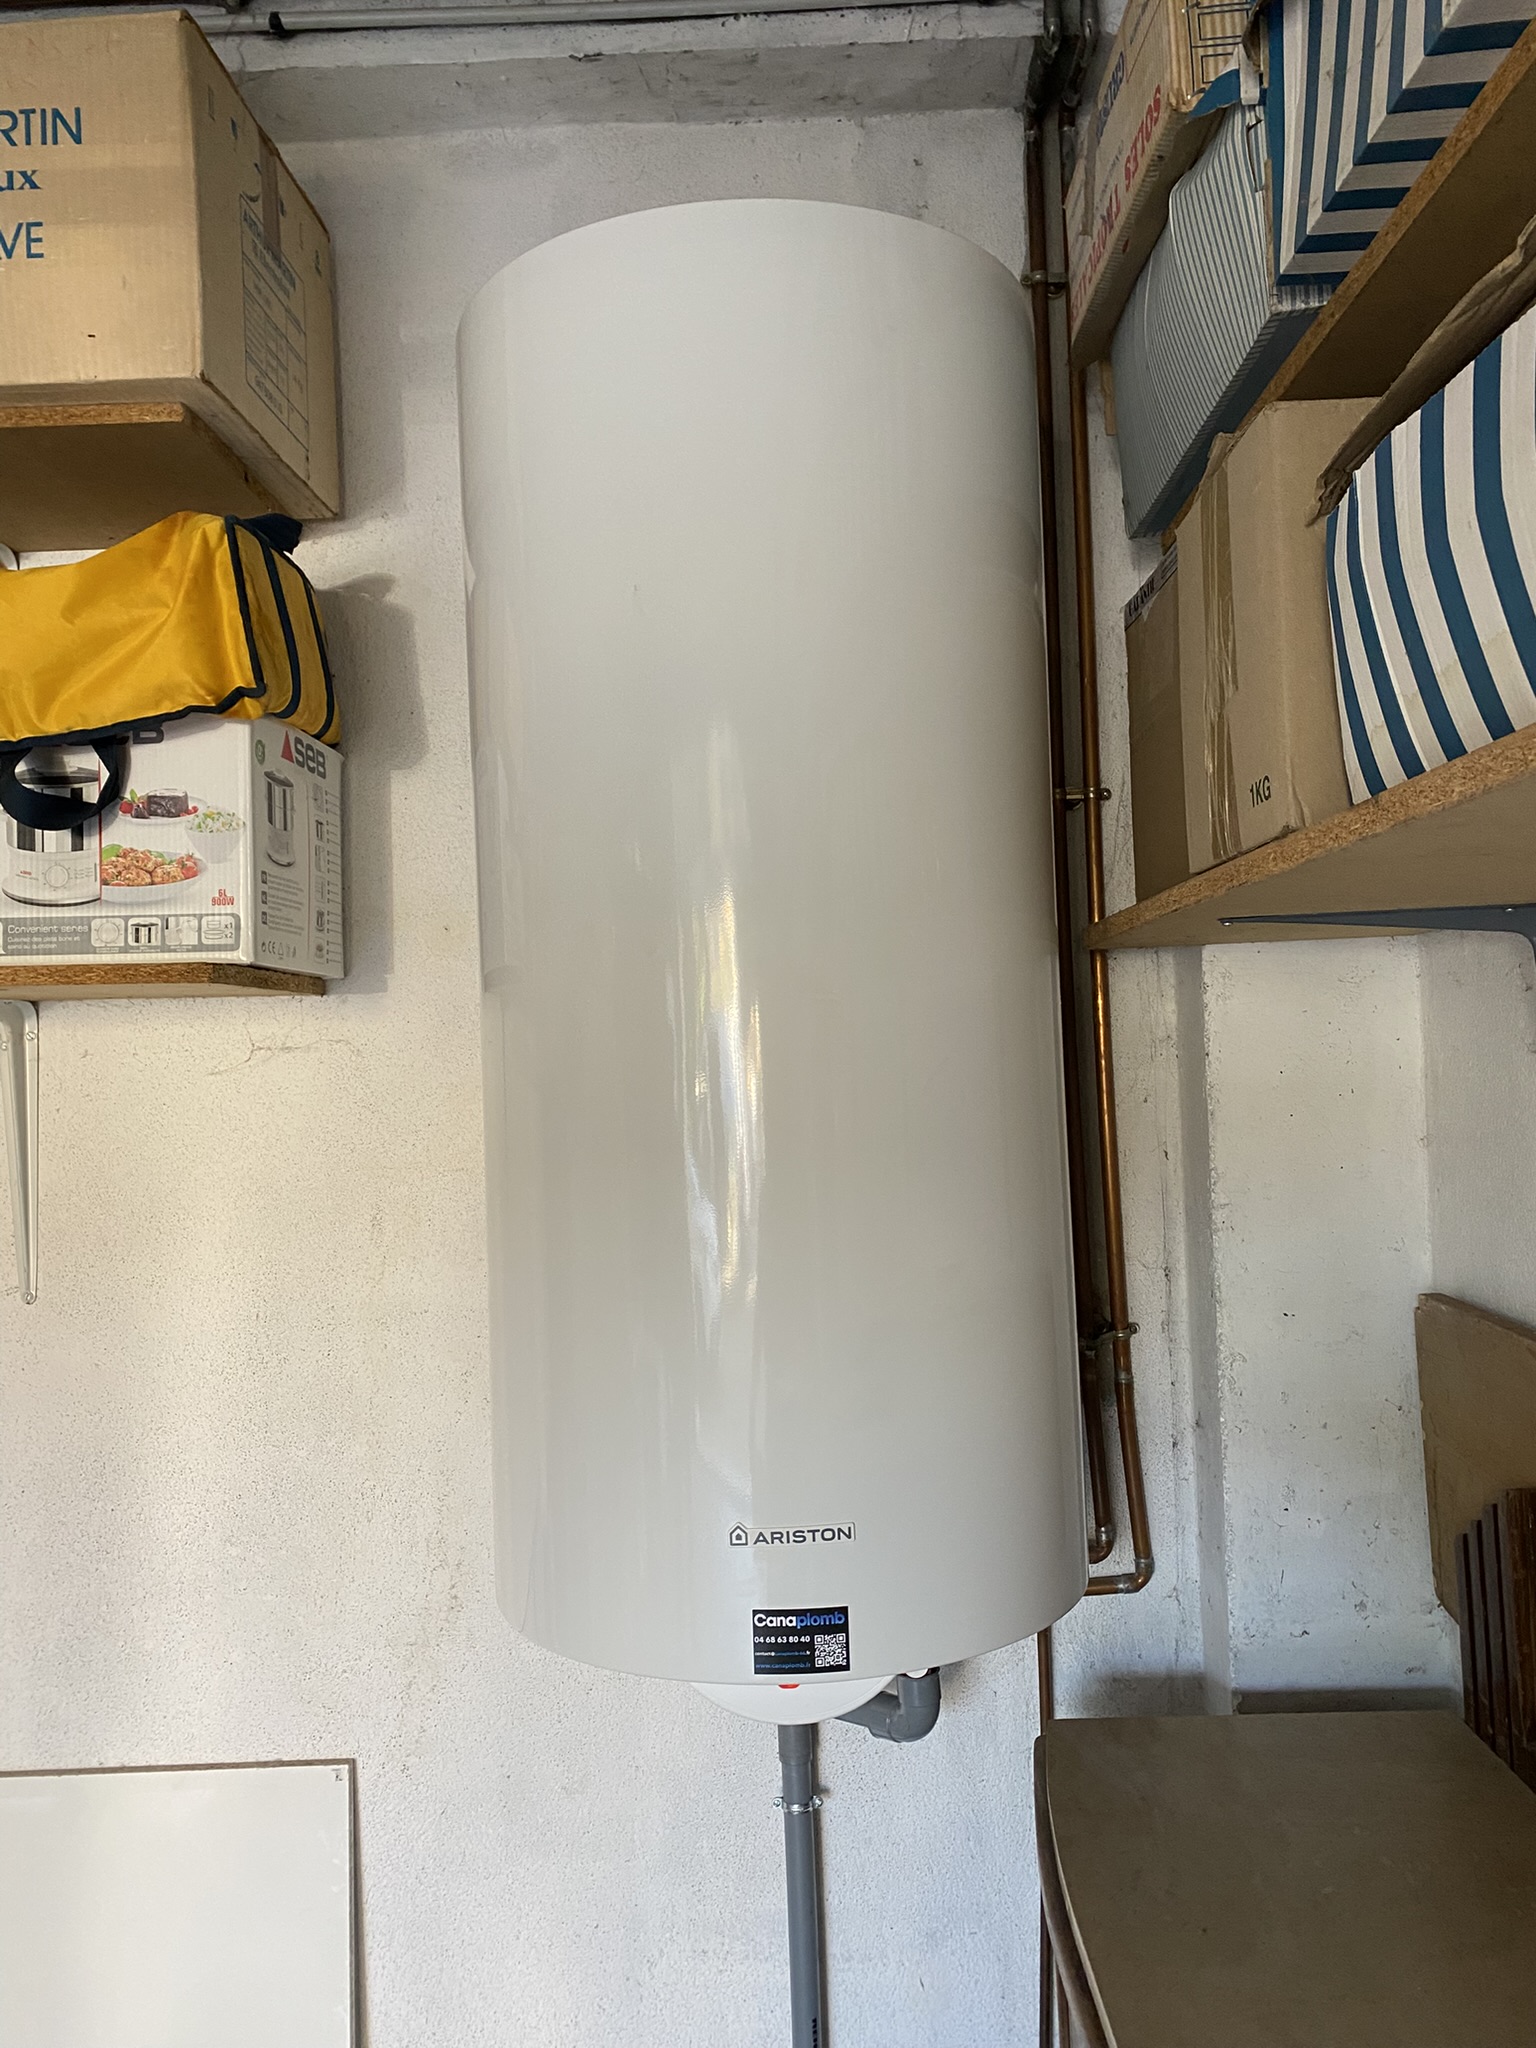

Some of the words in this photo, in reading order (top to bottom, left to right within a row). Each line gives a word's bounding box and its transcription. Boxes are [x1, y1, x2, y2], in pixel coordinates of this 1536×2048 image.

[0, 107, 82, 146] RTIN
[1125, 84, 1161, 192] SOLES
[0, 221, 44, 260] VE
[1250, 775, 1271, 808] 1KG
[211, 896, 235, 906] 900W
[7, 924, 59, 934] Convenient
[753, 1526, 852, 1545] ARISTON
[754, 1611, 846, 1629] Canaplomb
[800, 1635, 811, 1643] 40
